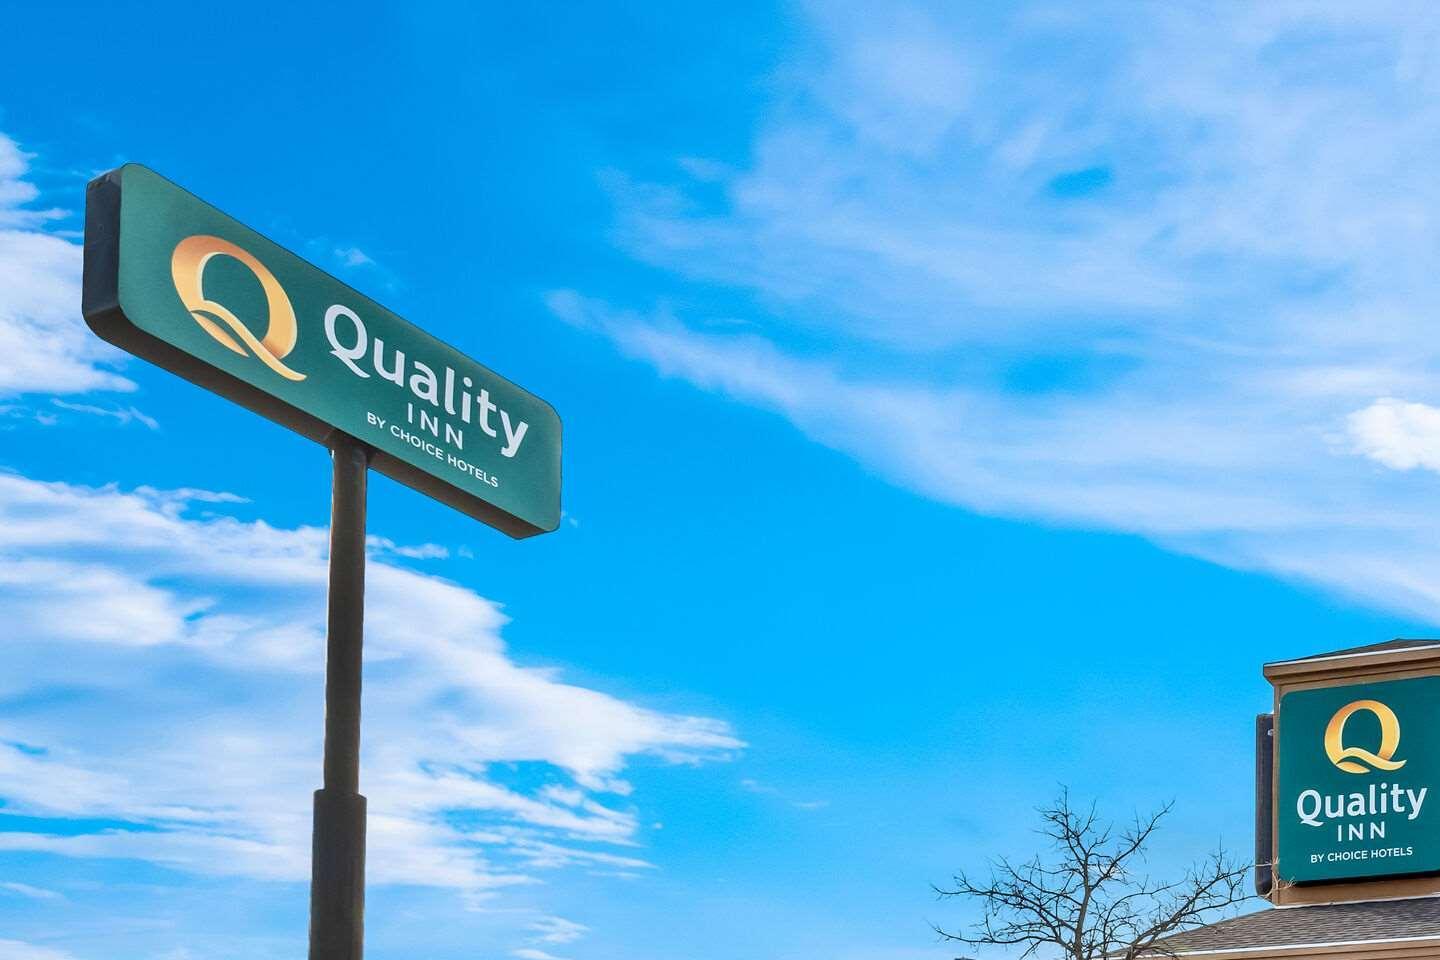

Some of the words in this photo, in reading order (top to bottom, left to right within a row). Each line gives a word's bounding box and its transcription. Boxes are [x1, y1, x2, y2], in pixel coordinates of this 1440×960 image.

[171, 235, 307, 382] Q
[324, 304, 529, 458] Quality
[367, 411, 386, 429] BY
[390, 424, 444, 461] CHOICE
[447, 454, 499, 488] HOTELS
[407, 402, 463, 450] INN
[1324, 700, 1407, 774] Q
[1296, 782, 1428, 827] Quality
[1337, 821, 1385, 842] INN
[1310, 854, 1325, 863] BY
[1327, 850, 1368, 862] CHOICE
[1370, 846, 1413, 859] HOTELS
